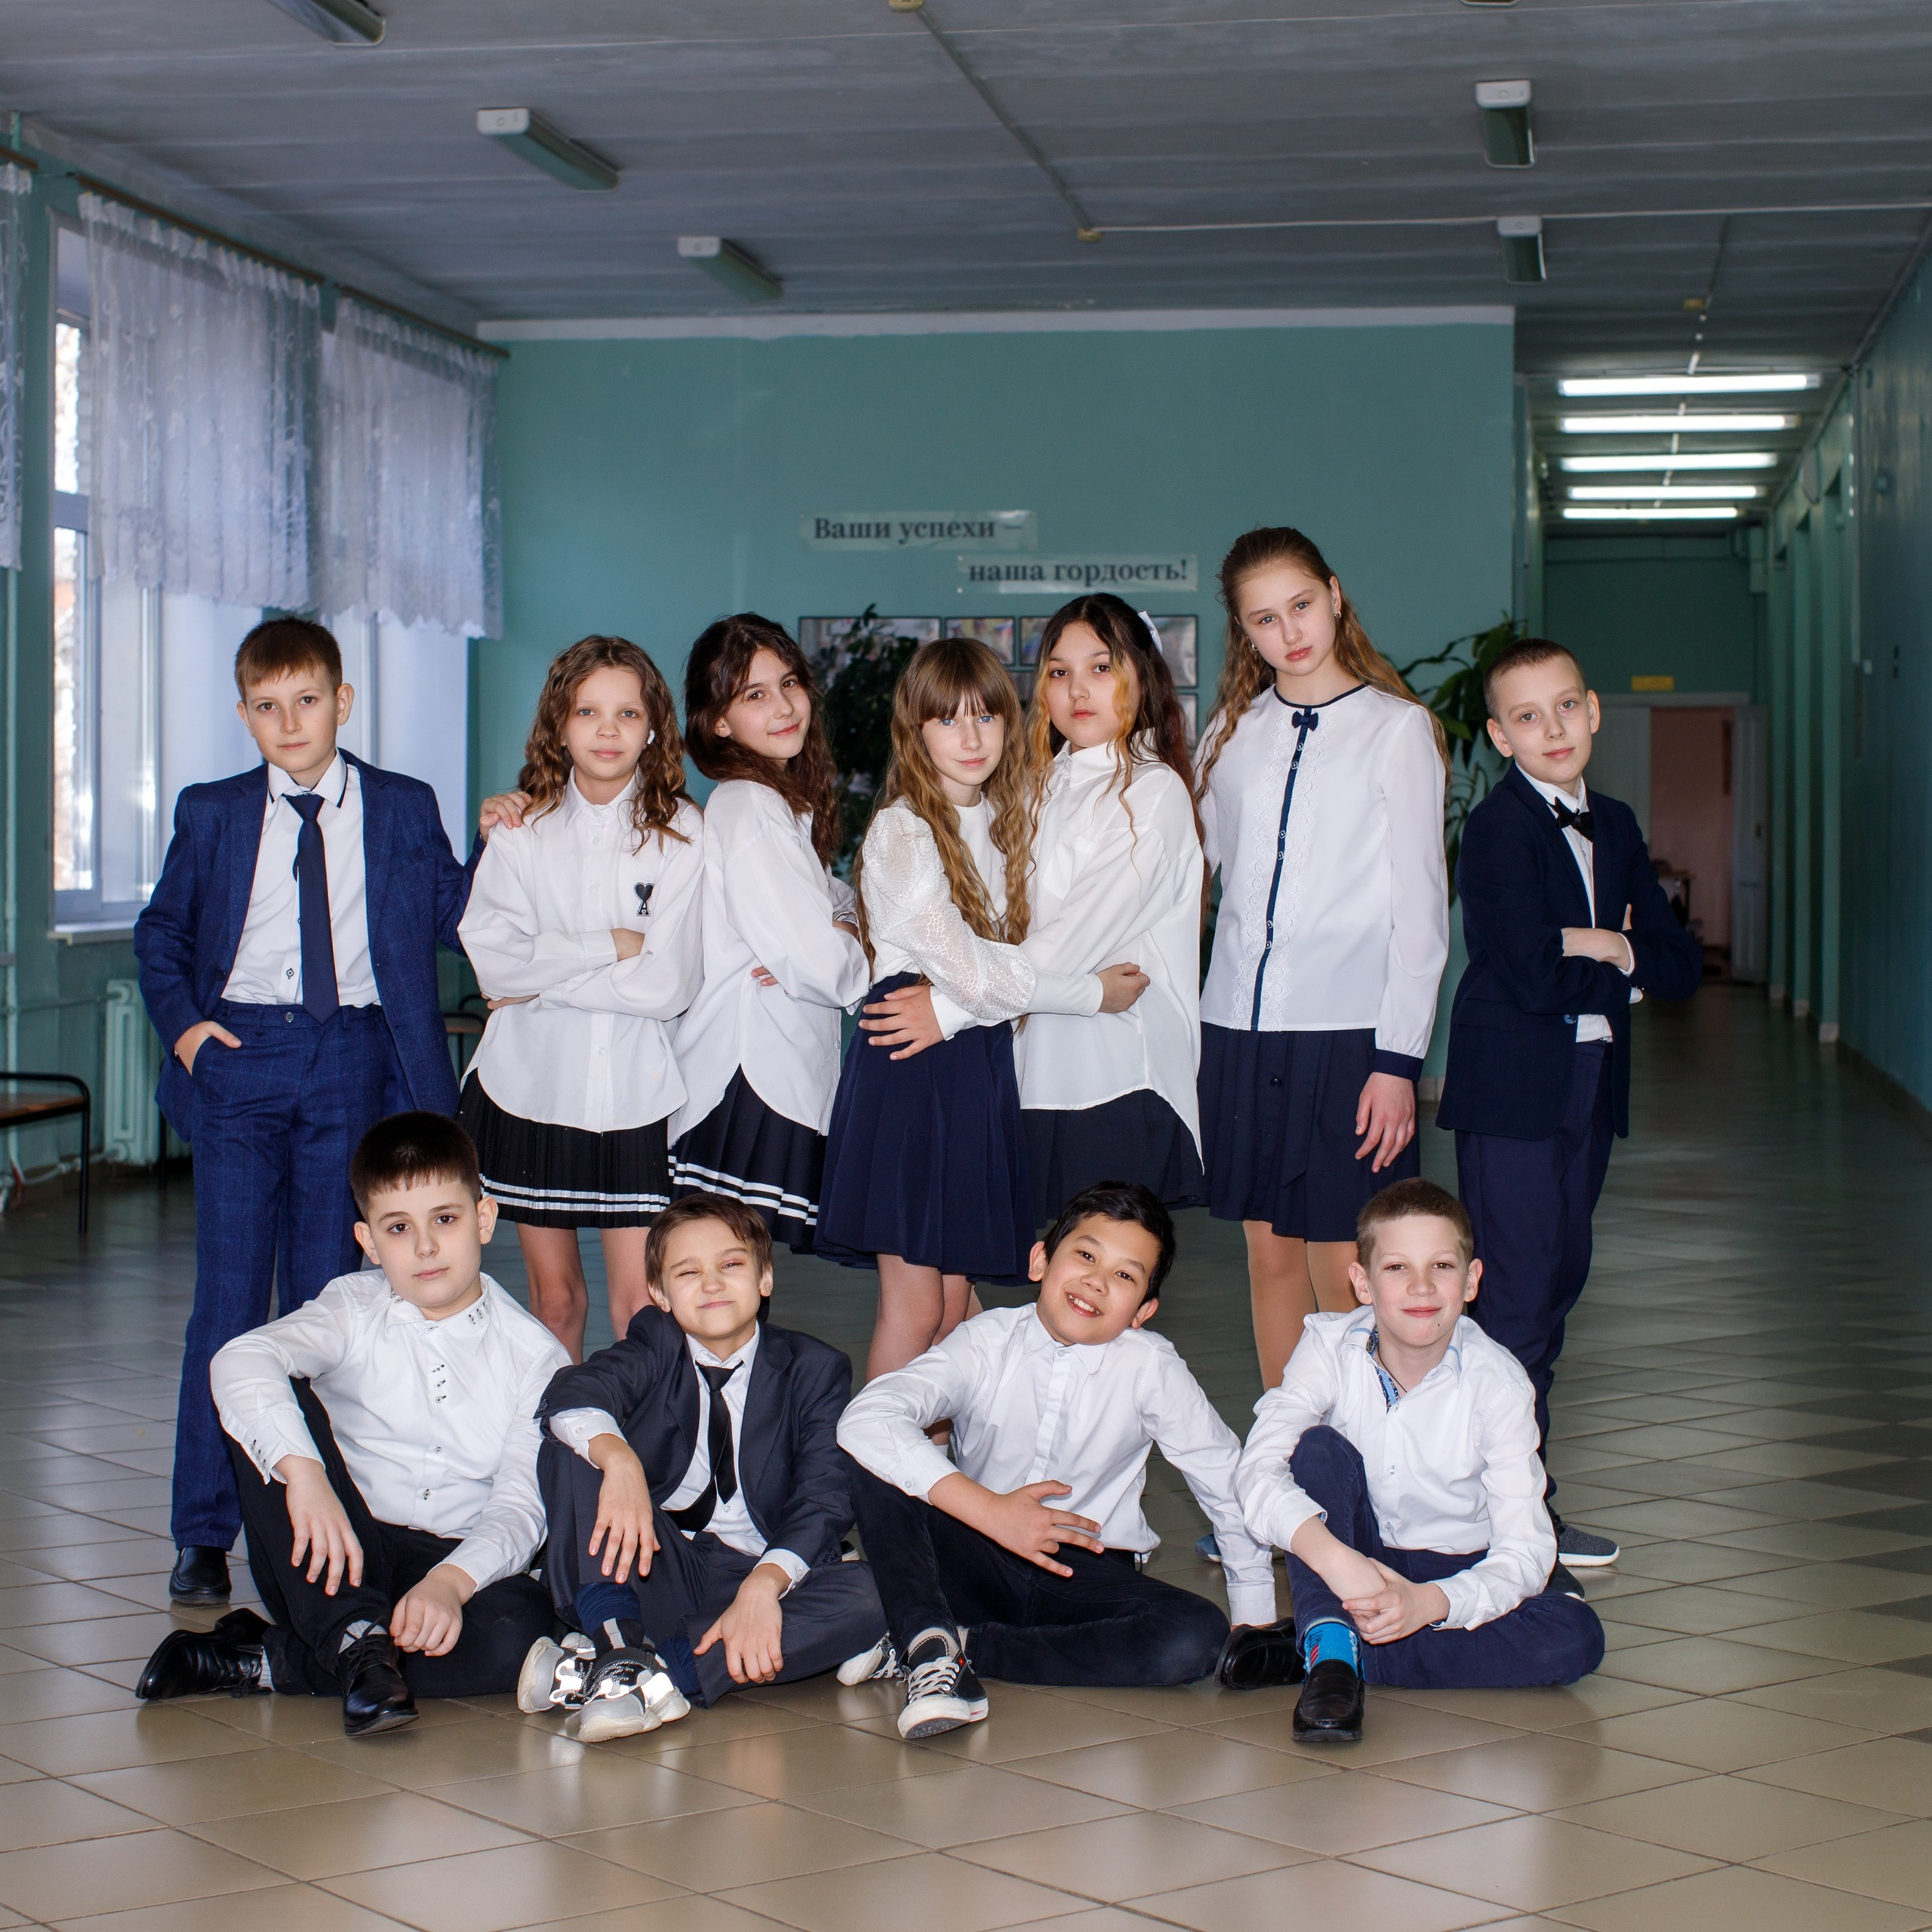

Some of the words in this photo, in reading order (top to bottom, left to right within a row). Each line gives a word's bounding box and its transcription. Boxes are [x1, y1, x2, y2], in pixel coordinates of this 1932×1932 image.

[814, 517, 891, 539] Ваши
[898, 518, 995, 544] успехи
[968, 562, 1044, 582] наша
[1055, 559, 1187, 586] гордость!
